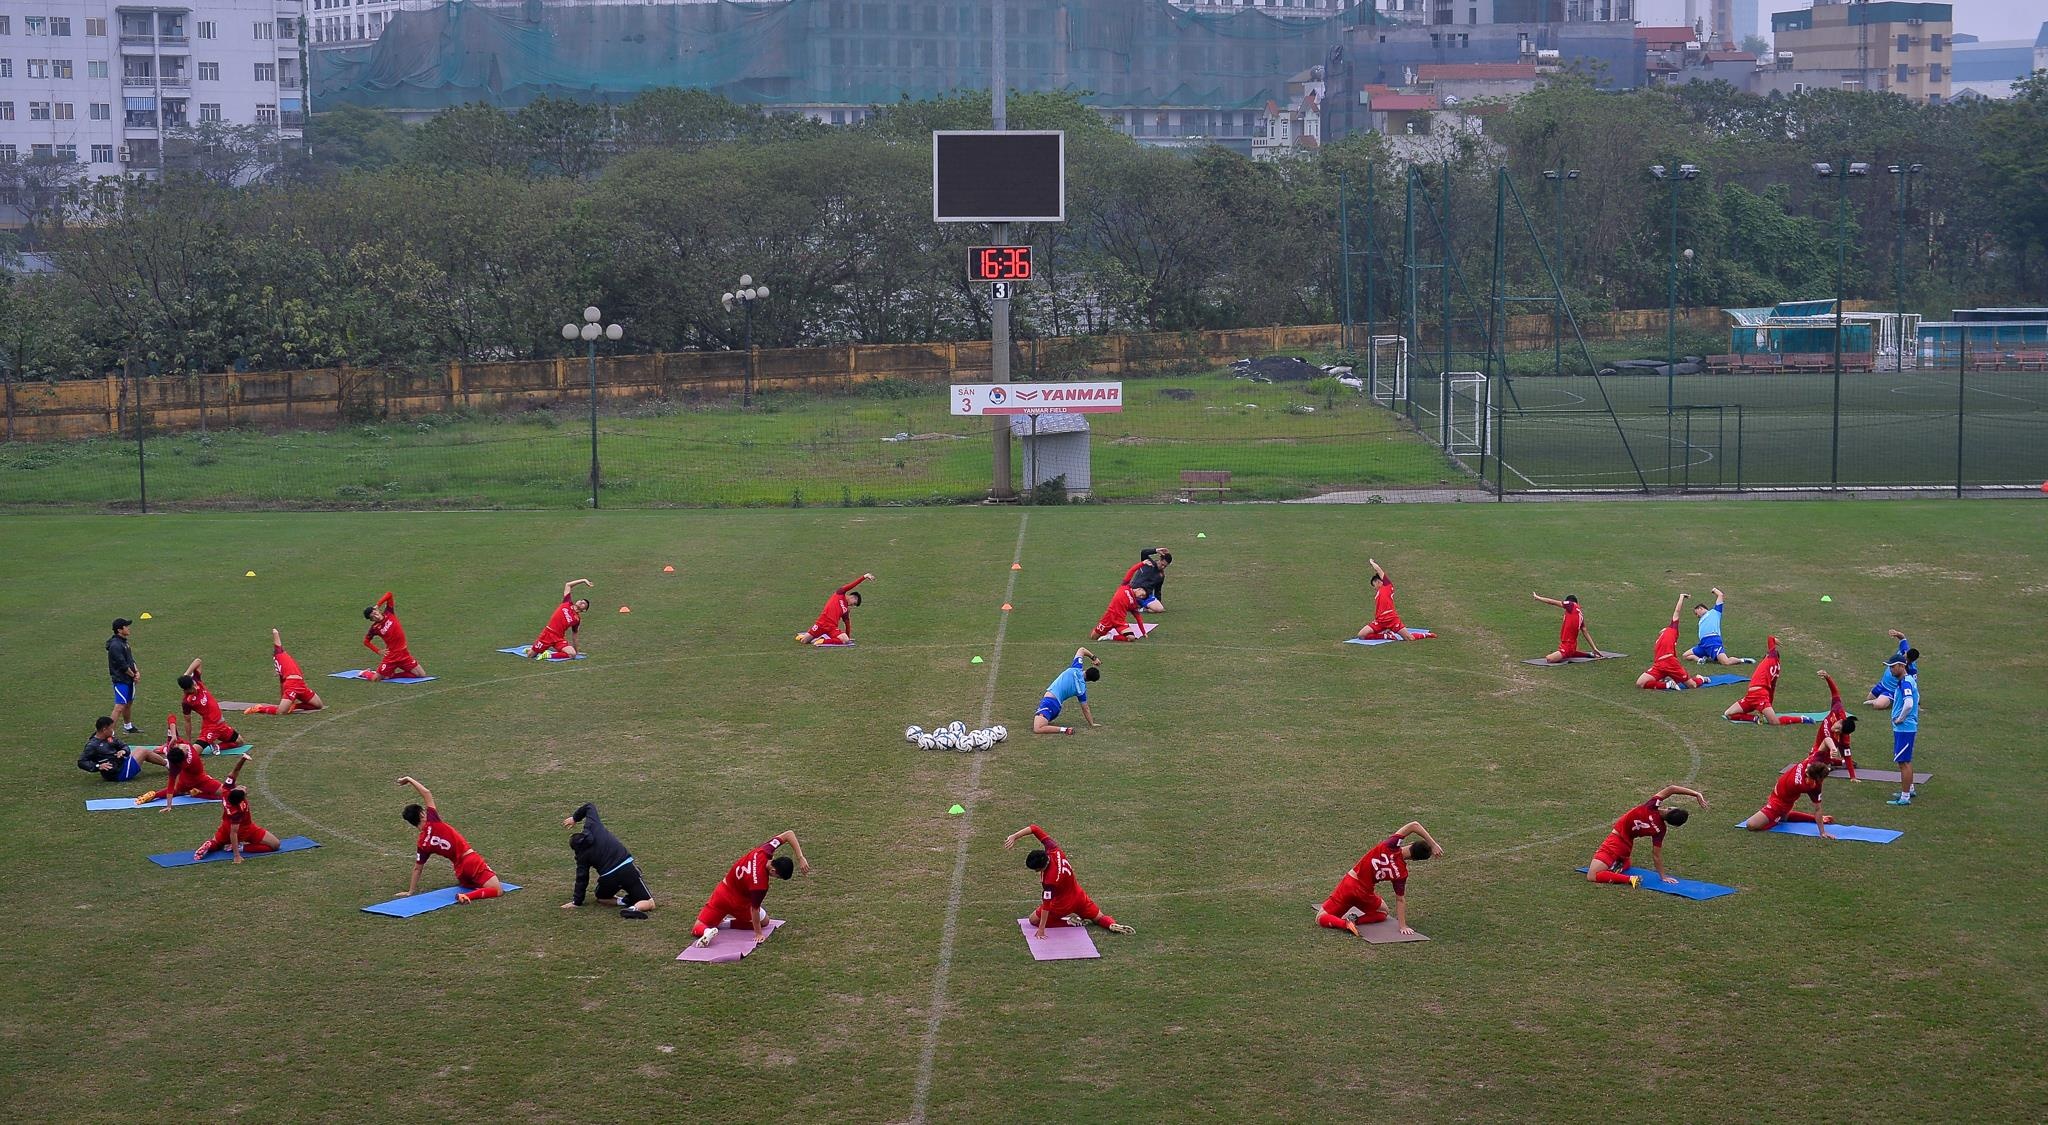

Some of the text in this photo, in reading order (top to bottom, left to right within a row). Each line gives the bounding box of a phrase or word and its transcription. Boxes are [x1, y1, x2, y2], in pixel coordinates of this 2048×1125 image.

[981, 249, 1029, 278] 16:36
[995, 283, 1005, 298] 3
[1041, 388, 1119, 400] YANMAR
[962, 398, 972, 412] 3
[430, 835, 451, 850] 8
[735, 860, 751, 880] 3
